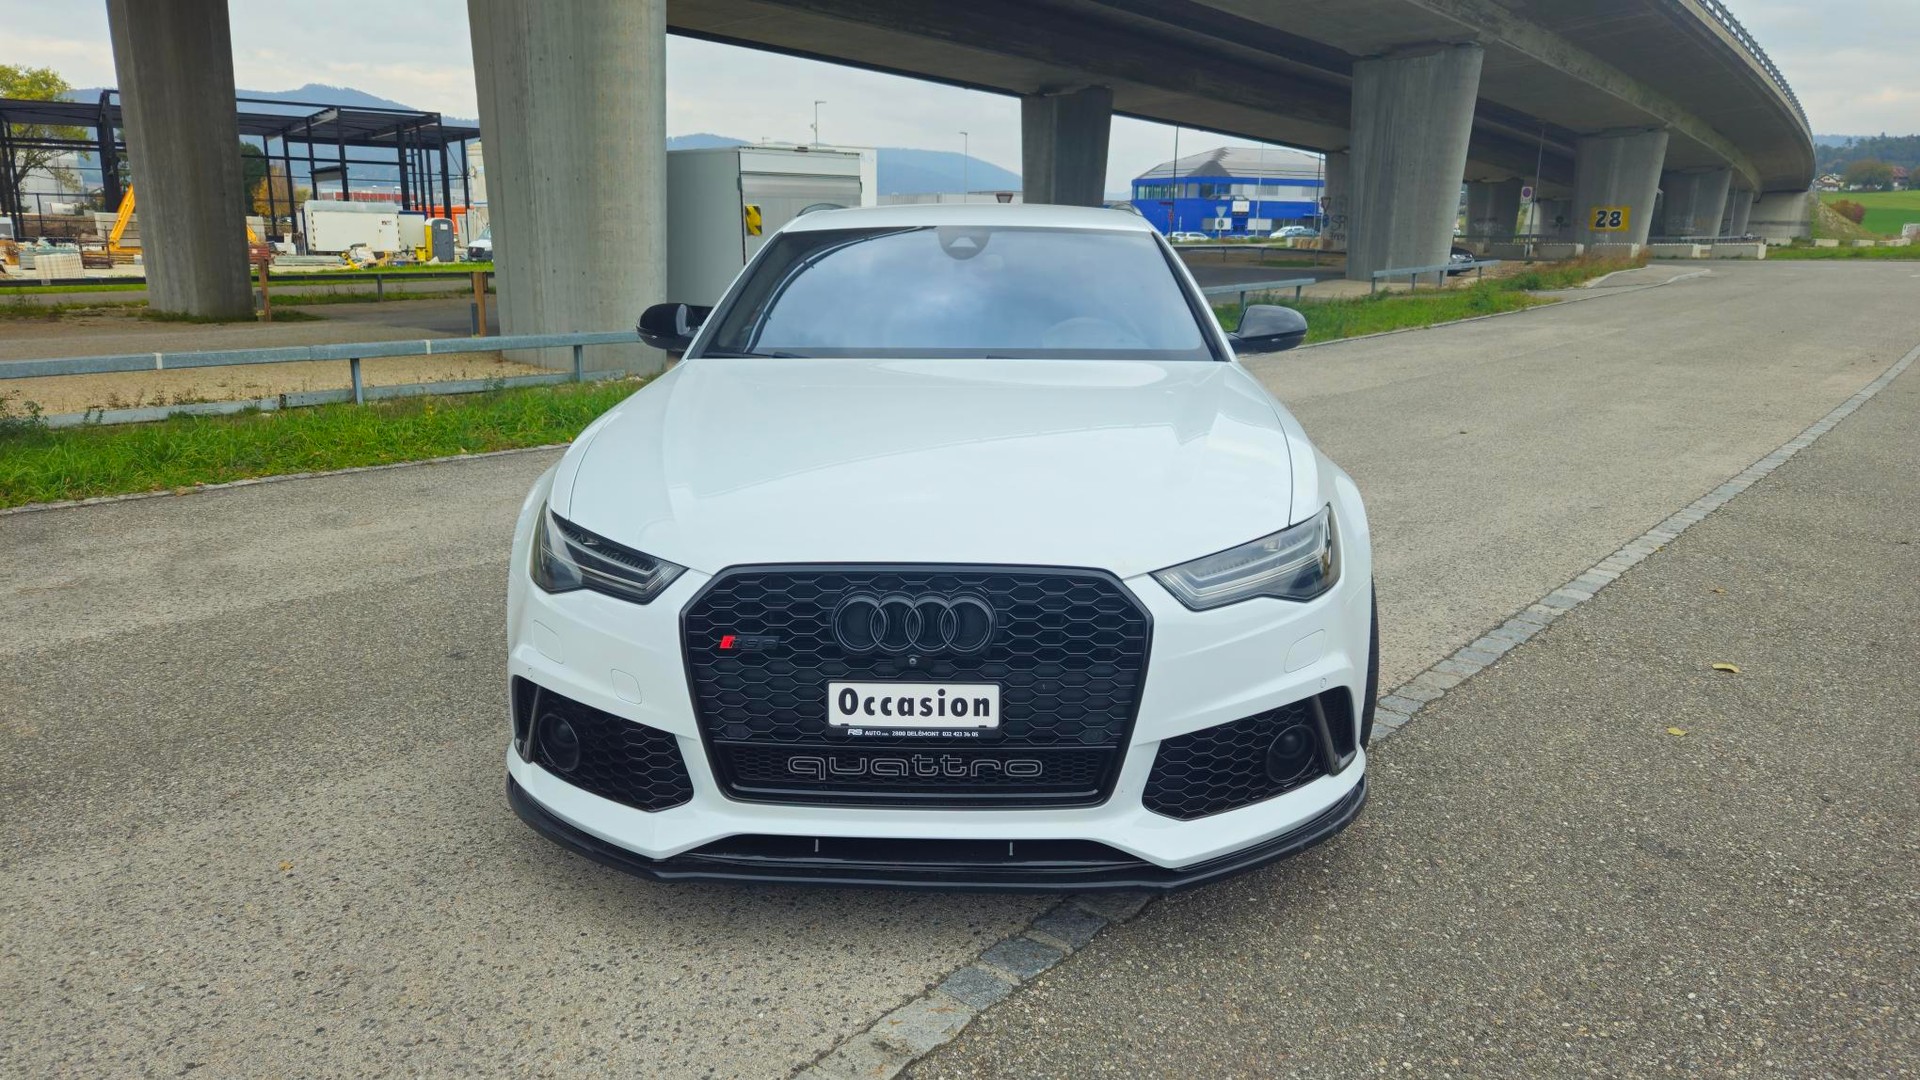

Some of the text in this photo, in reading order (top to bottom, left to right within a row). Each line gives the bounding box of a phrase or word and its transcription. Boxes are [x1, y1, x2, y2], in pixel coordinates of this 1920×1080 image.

[1595, 210, 1622, 228] 28
[838, 687, 990, 717] Occasion
[906, 729, 939, 737] DELÉMONT
[788, 754, 1043, 781] quattro
